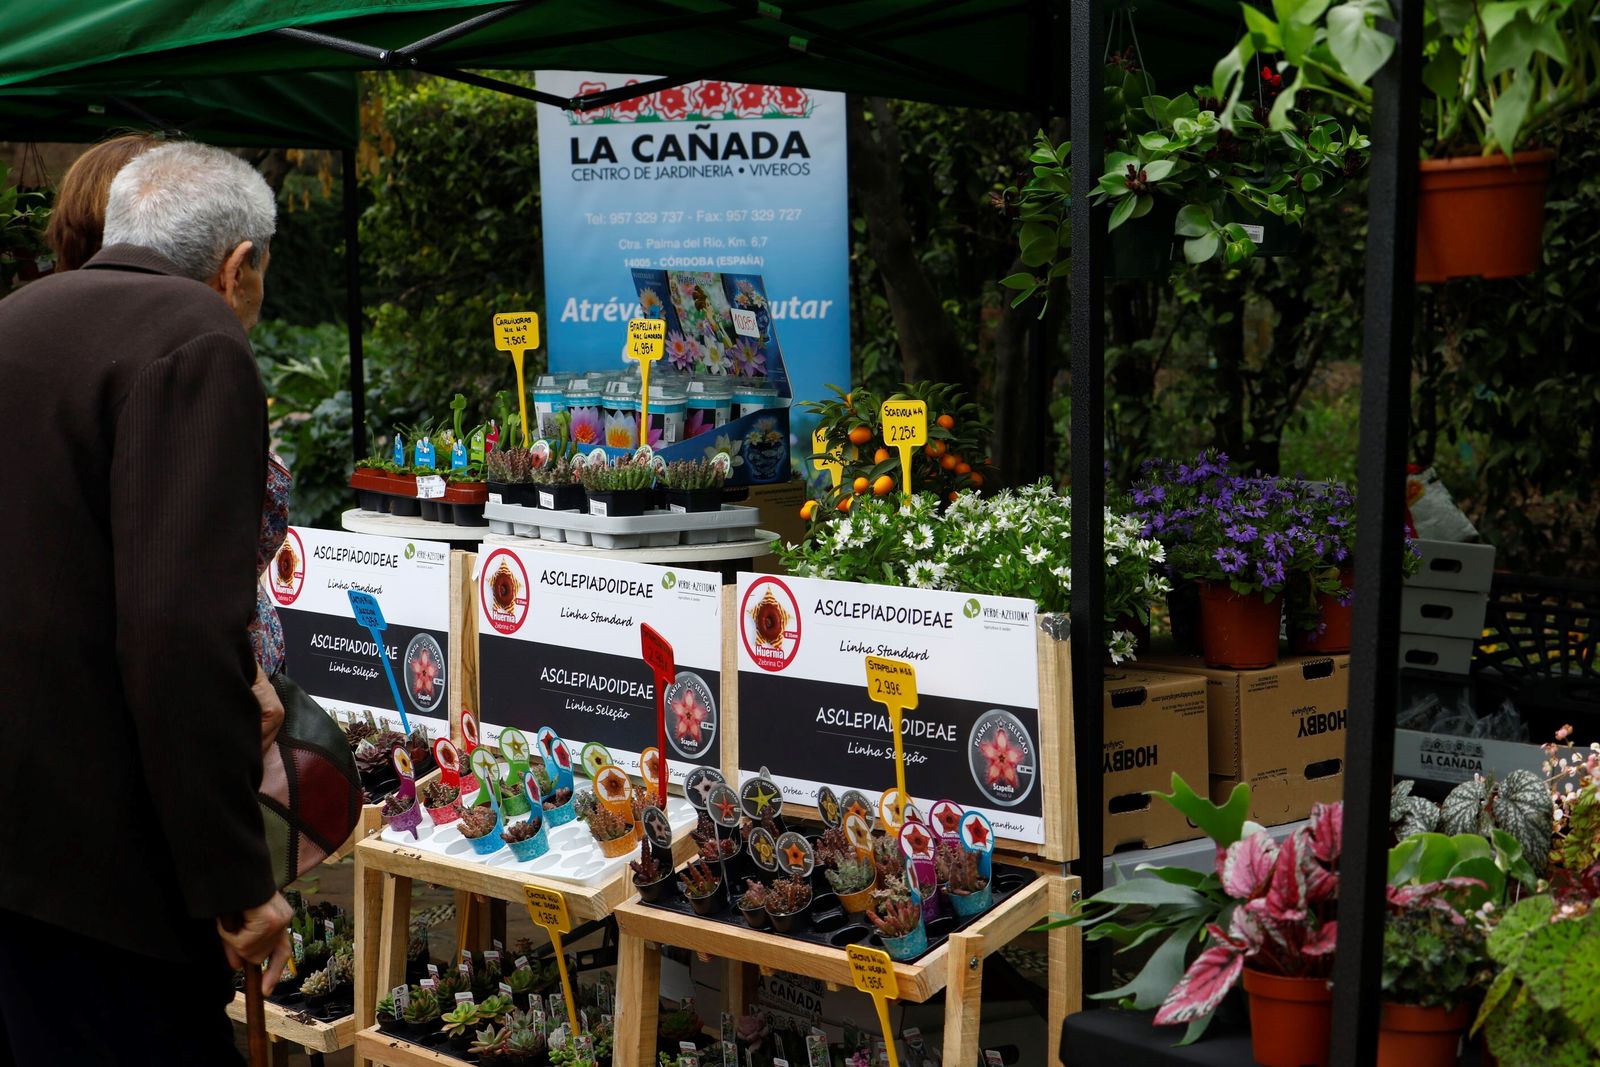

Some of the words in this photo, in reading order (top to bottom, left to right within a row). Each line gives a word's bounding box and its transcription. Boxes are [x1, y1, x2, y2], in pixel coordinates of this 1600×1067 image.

[571, 136, 618, 165] LA
[631, 123, 811, 163] CAÑADA
[571, 167, 630, 181] CENTRO
[634, 166, 651, 180] DE
[654, 164, 734, 180] JARDINERIA
[749, 162, 810, 176] VIVEROS
[610, 212, 633, 225] 957
[634, 212, 658, 224] 329
[661, 211, 684, 224] 737
[726, 209, 748, 222] 957
[751, 209, 775, 222] 329
[779, 208, 802, 221] 727
[646, 238, 681, 250] Palma
[683, 238, 700, 249] del
[503, 335, 527, 346] 7.50€
[633, 342, 654, 356] 4.95€
[891, 425, 916, 442] 2.25€
[313, 545, 399, 568] ASCLEPIADOIDEAE
[327, 579, 349, 590] Linha
[350, 582, 383, 594] Standard
[540, 569, 654, 598] ASCLEPIADOIDEAE
[560, 607, 589, 621] Linha
[590, 611, 634, 627] Standard
[814, 599, 953, 629] ASCLEPIADOIDEAE
[756, 645, 784, 658] Huernia
[839, 640, 875, 656] Linha
[876, 643, 930, 661] Standard
[328, 661, 352, 674] Linha
[352, 665, 380, 680] Seleção
[758, 659, 777, 668] Zebrina
[540, 666, 654, 700] ASCLEPIADOIDEAE
[874, 678, 902, 696] 2.99€
[667, 682, 682, 705] PLANTA
[694, 683, 711, 713] SELEÇÃO
[565, 698, 594, 714] Linha
[595, 703, 631, 721] Seleção
[1297, 709, 1348, 738] HOBBY
[974, 721, 992, 747] PLANTA
[1007, 722, 1029, 755] SELEÇÃO
[847, 741, 882, 758] Linha
[884, 746, 928, 765] Seeção
[1103, 744, 1158, 775] HOBBY
[1420, 753, 1433, 764] LA
[1436, 751, 1483, 771] CAÑADA
[687, 774, 697, 790] PLANTA
[782, 785, 803, 796] Orbea
[770, 979, 822, 1016] CAÑADA
